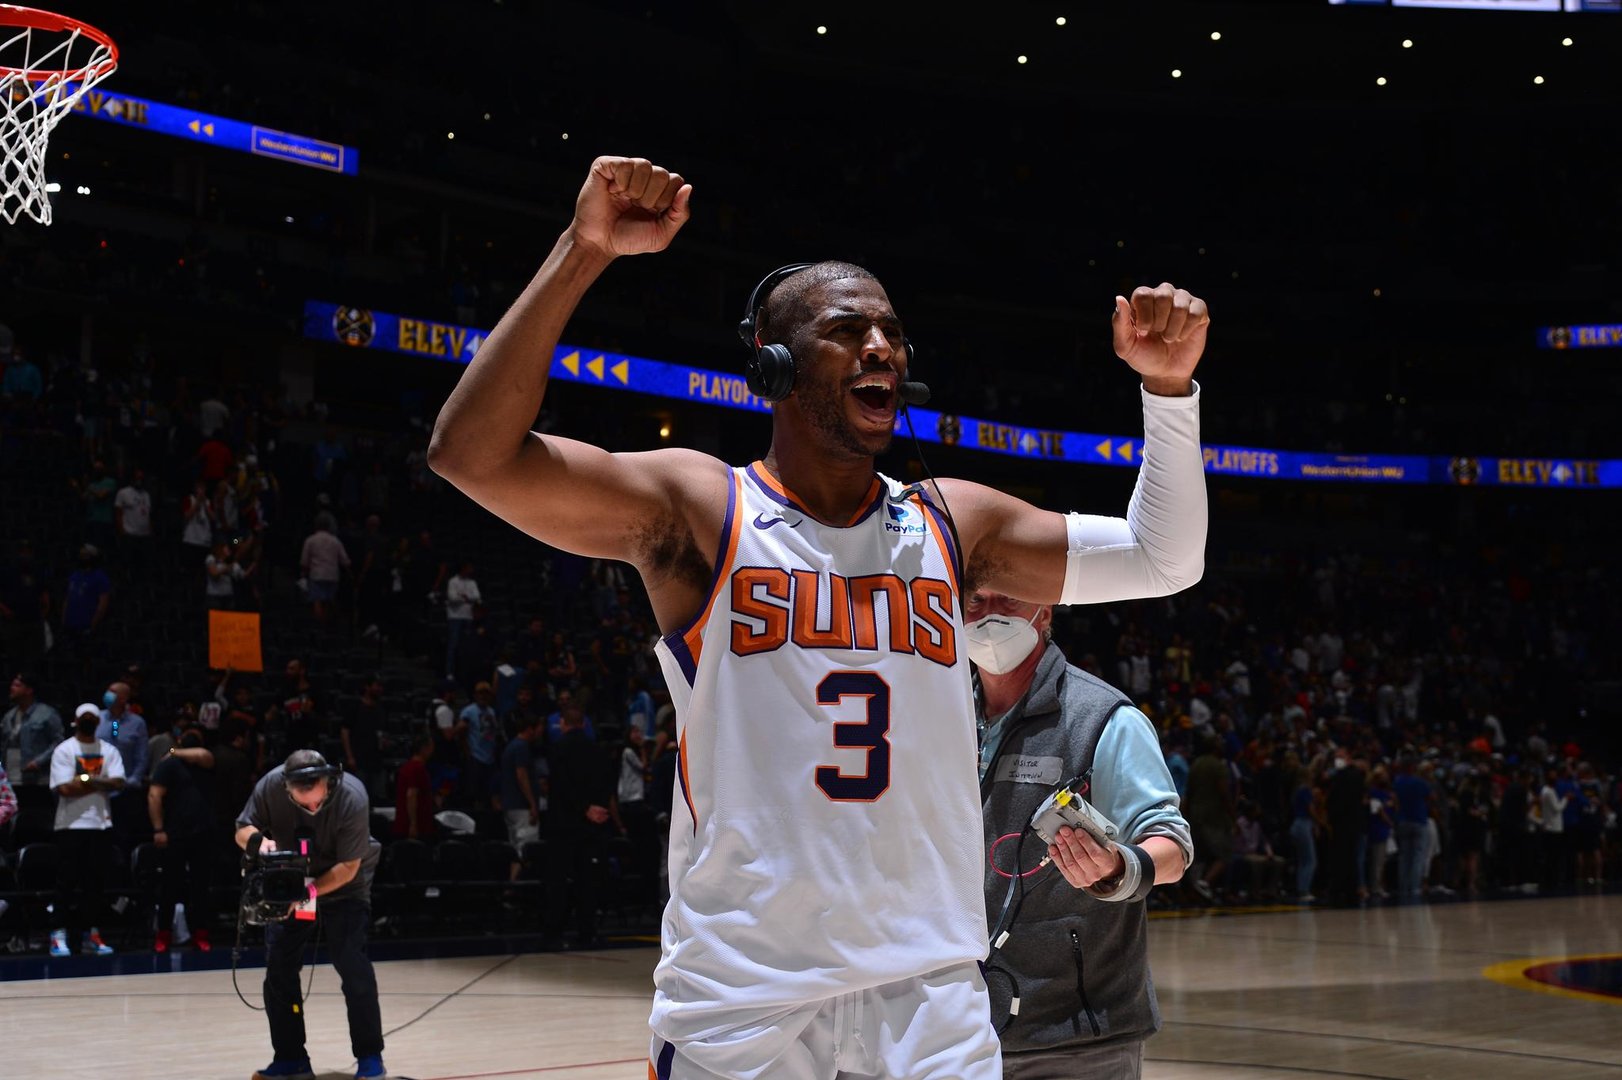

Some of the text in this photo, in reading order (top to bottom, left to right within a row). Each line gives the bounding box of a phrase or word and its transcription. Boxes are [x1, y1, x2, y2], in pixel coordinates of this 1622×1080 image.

[689, 372, 772, 409] PLAYOF
[1203, 447, 1279, 475] PLAYOFFS
[885, 522, 926, 533] PayPal
[730, 566, 957, 668] SUNS
[815, 670, 890, 802] 3
